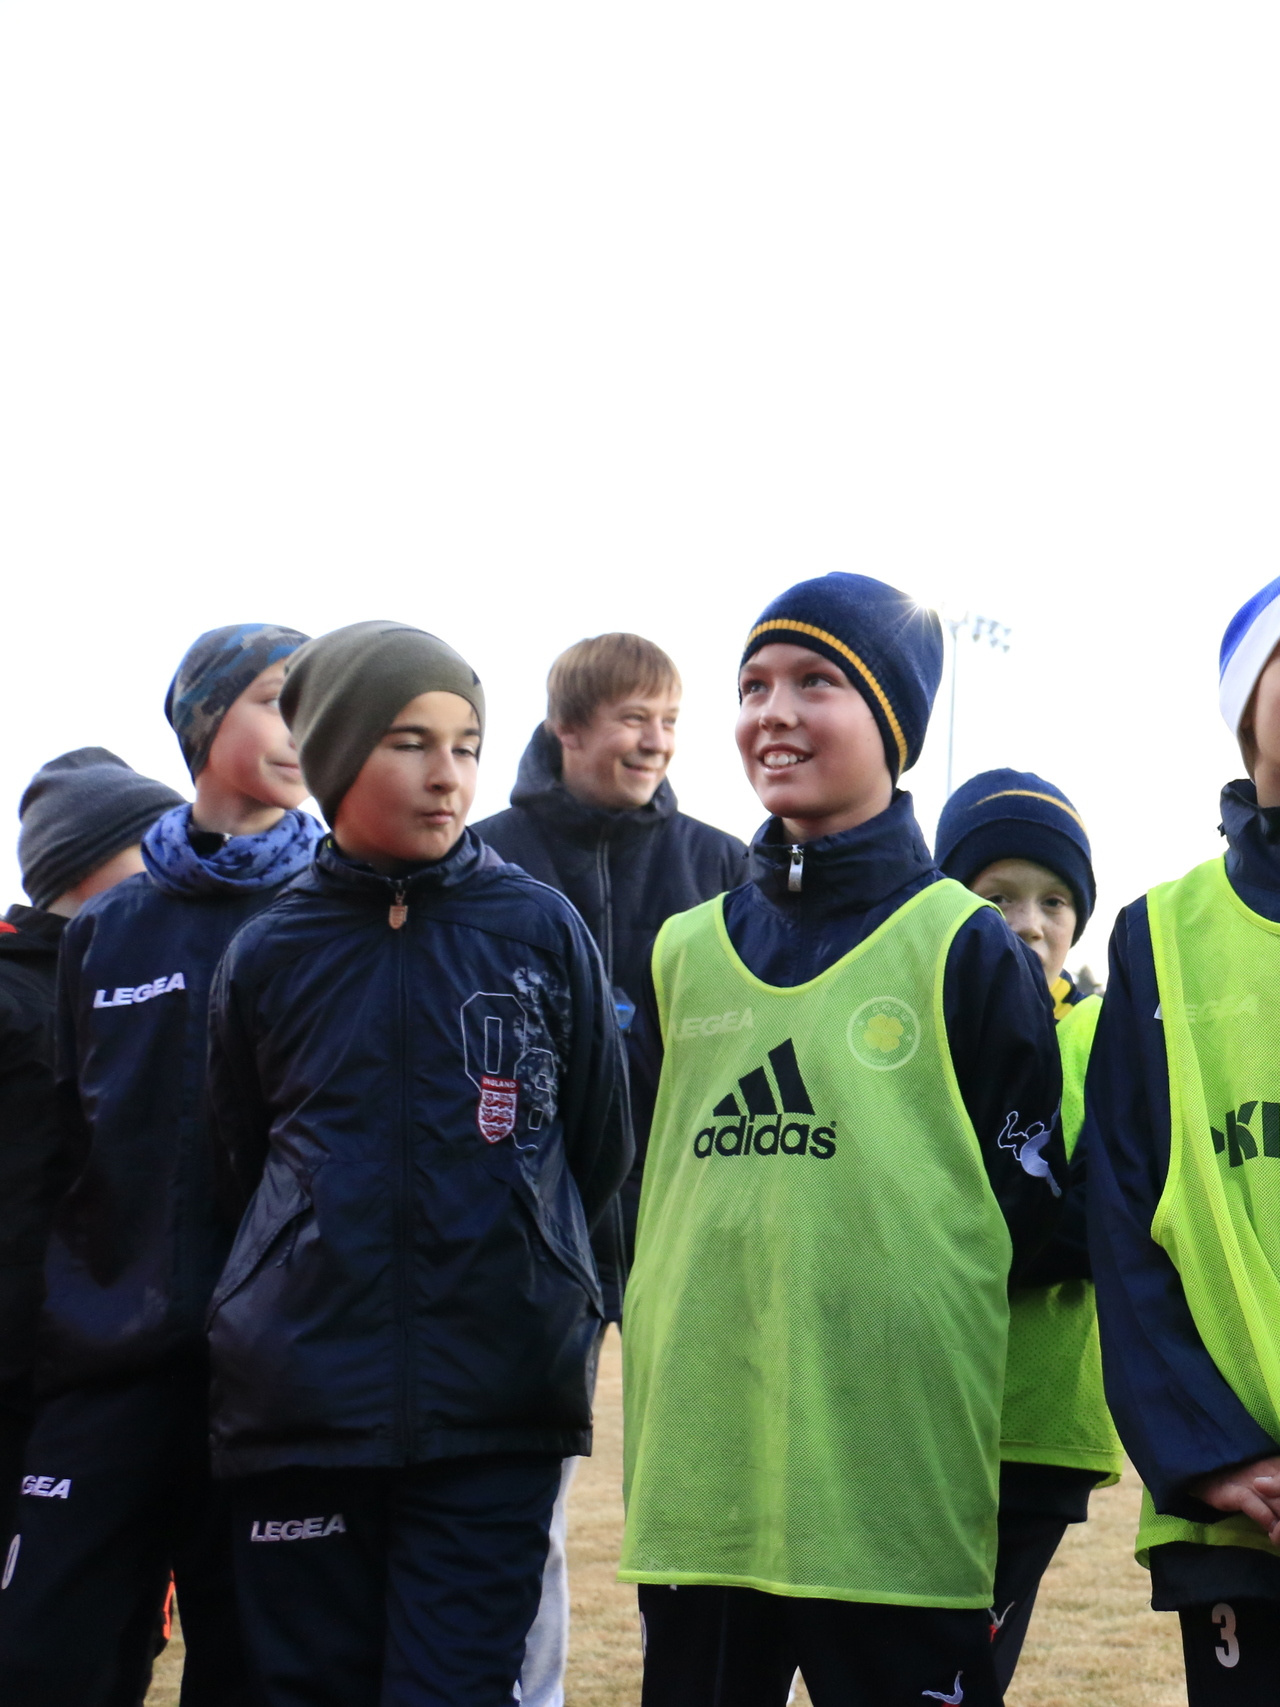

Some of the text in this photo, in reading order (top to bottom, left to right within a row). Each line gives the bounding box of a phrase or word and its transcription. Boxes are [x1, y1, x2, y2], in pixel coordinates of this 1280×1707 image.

[93, 972, 186, 1009] LEGEA
[482, 1077, 517, 1089] ENGLAND
[693, 1115, 837, 1160] adidas
[251, 1513, 347, 1542] LEGEA
[1211, 1602, 1241, 1669] 3
